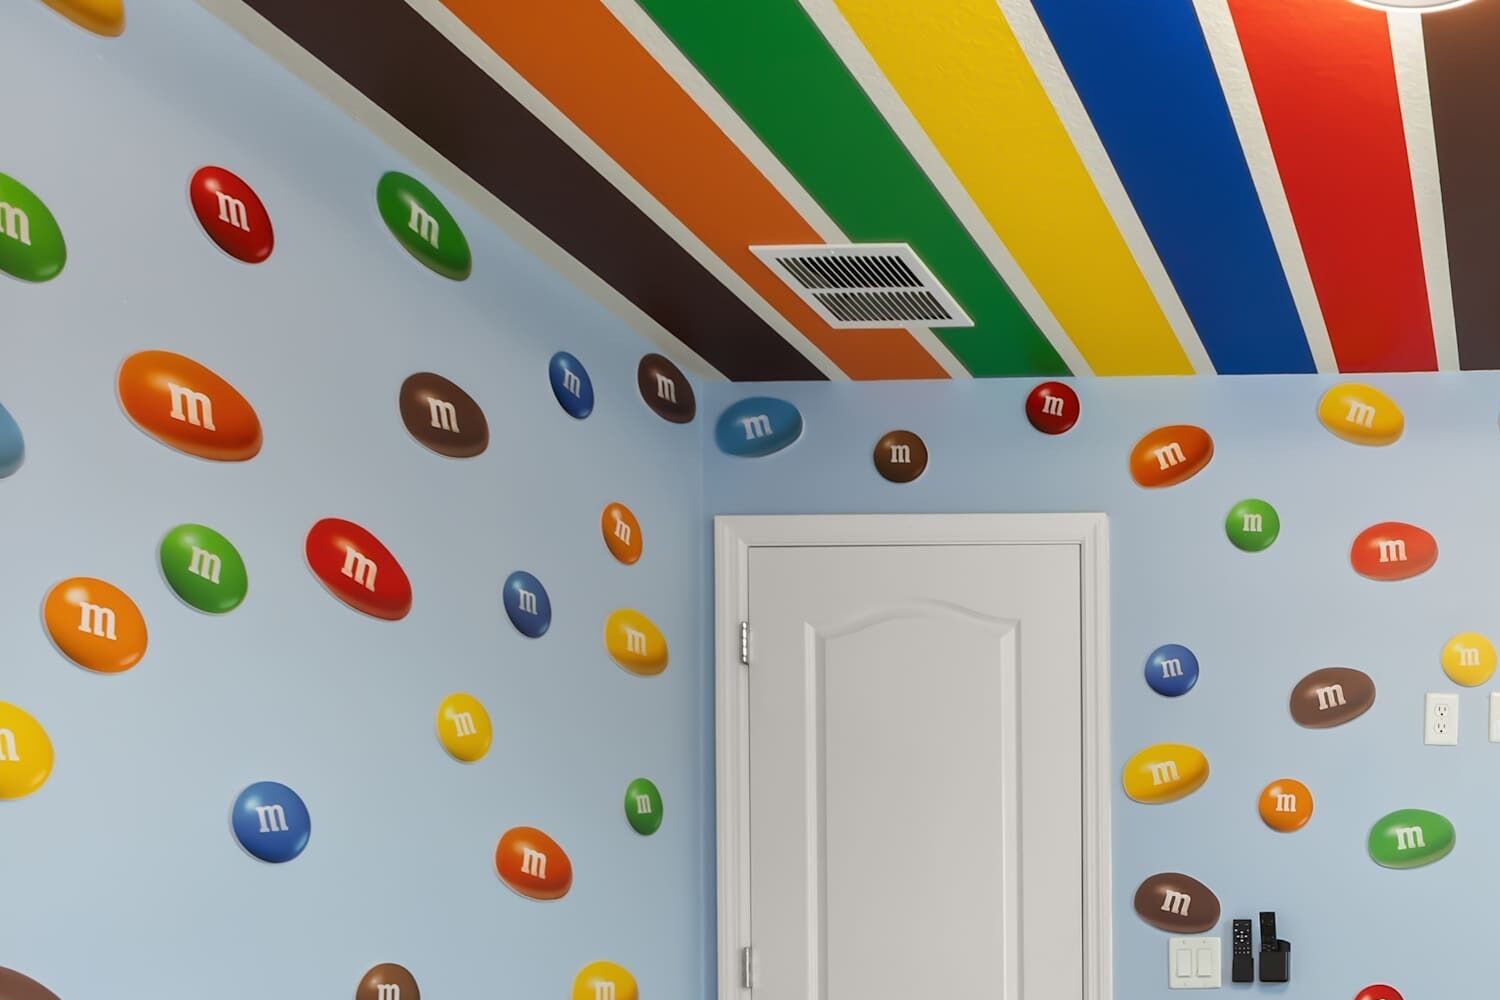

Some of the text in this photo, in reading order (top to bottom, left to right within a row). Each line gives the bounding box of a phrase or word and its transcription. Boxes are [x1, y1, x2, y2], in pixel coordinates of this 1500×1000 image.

[216, 190, 250, 232] m
[408, 199, 439, 249] m
[562, 367, 582, 398] m
[655, 372, 677, 403] m
[168, 381, 216, 432] m
[429, 395, 459, 433] m
[1042, 395, 1064, 416] m
[1346, 400, 1376, 428] m
[742, 413, 774, 440] m
[890, 444, 911, 464] m
[1153, 442, 1187, 470] m
[614, 517, 631, 546] m
[1242, 513, 1263, 532] m
[188, 544, 221, 585] m
[1378, 539, 1408, 563] m
[341, 547, 378, 592] m
[518, 587, 538, 616] m
[77, 602, 117, 641] m
[625, 628, 647, 657] m
[1459, 647, 1480, 666] m
[1161, 658, 1183, 679] m
[1316, 682, 1346, 711] m
[453, 711, 476, 736] m
[1150, 760, 1181, 786] m
[636, 793, 652, 815] m
[1276, 793, 1297, 812] m
[256, 805, 288, 834] m
[1395, 825, 1426, 850] m
[522, 848, 547, 879] m
[1161, 889, 1192, 917] m
